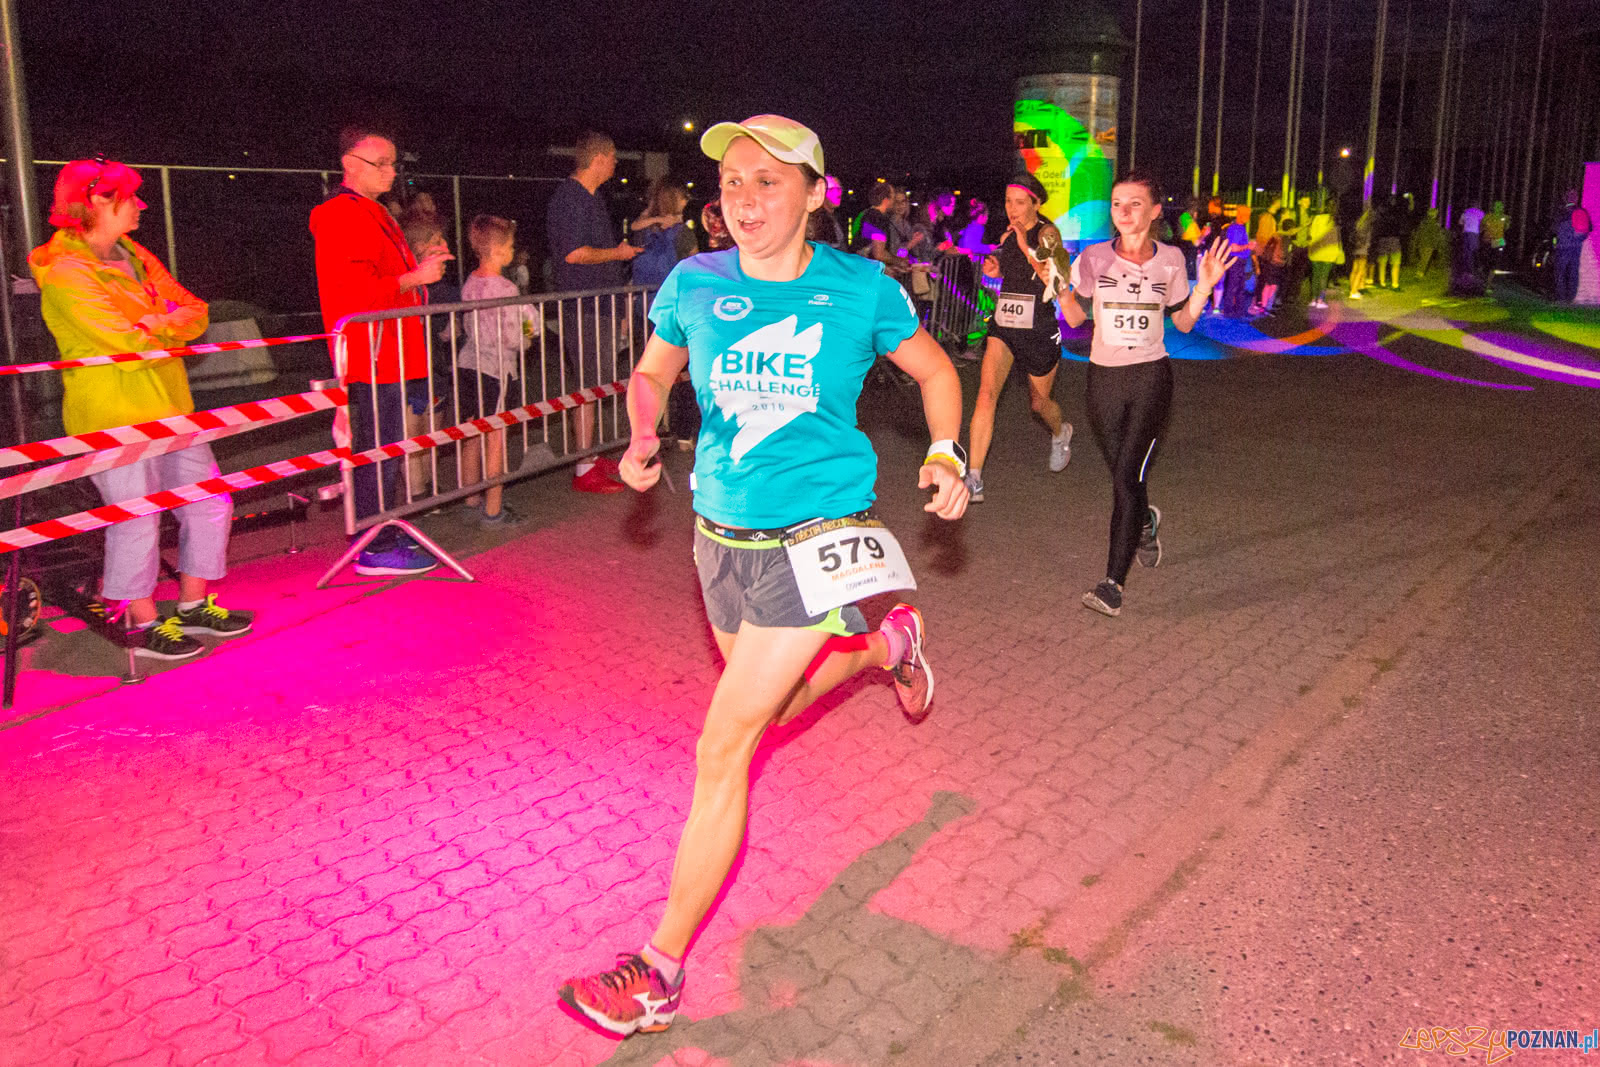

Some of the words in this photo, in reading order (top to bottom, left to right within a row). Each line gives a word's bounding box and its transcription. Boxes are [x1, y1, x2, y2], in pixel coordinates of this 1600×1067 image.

[1001, 303, 1024, 315] 440
[1114, 315, 1149, 330] 519
[721, 350, 807, 379] BIKE
[818, 536, 885, 572] 579
[832, 562, 886, 581] MAGDALENA
